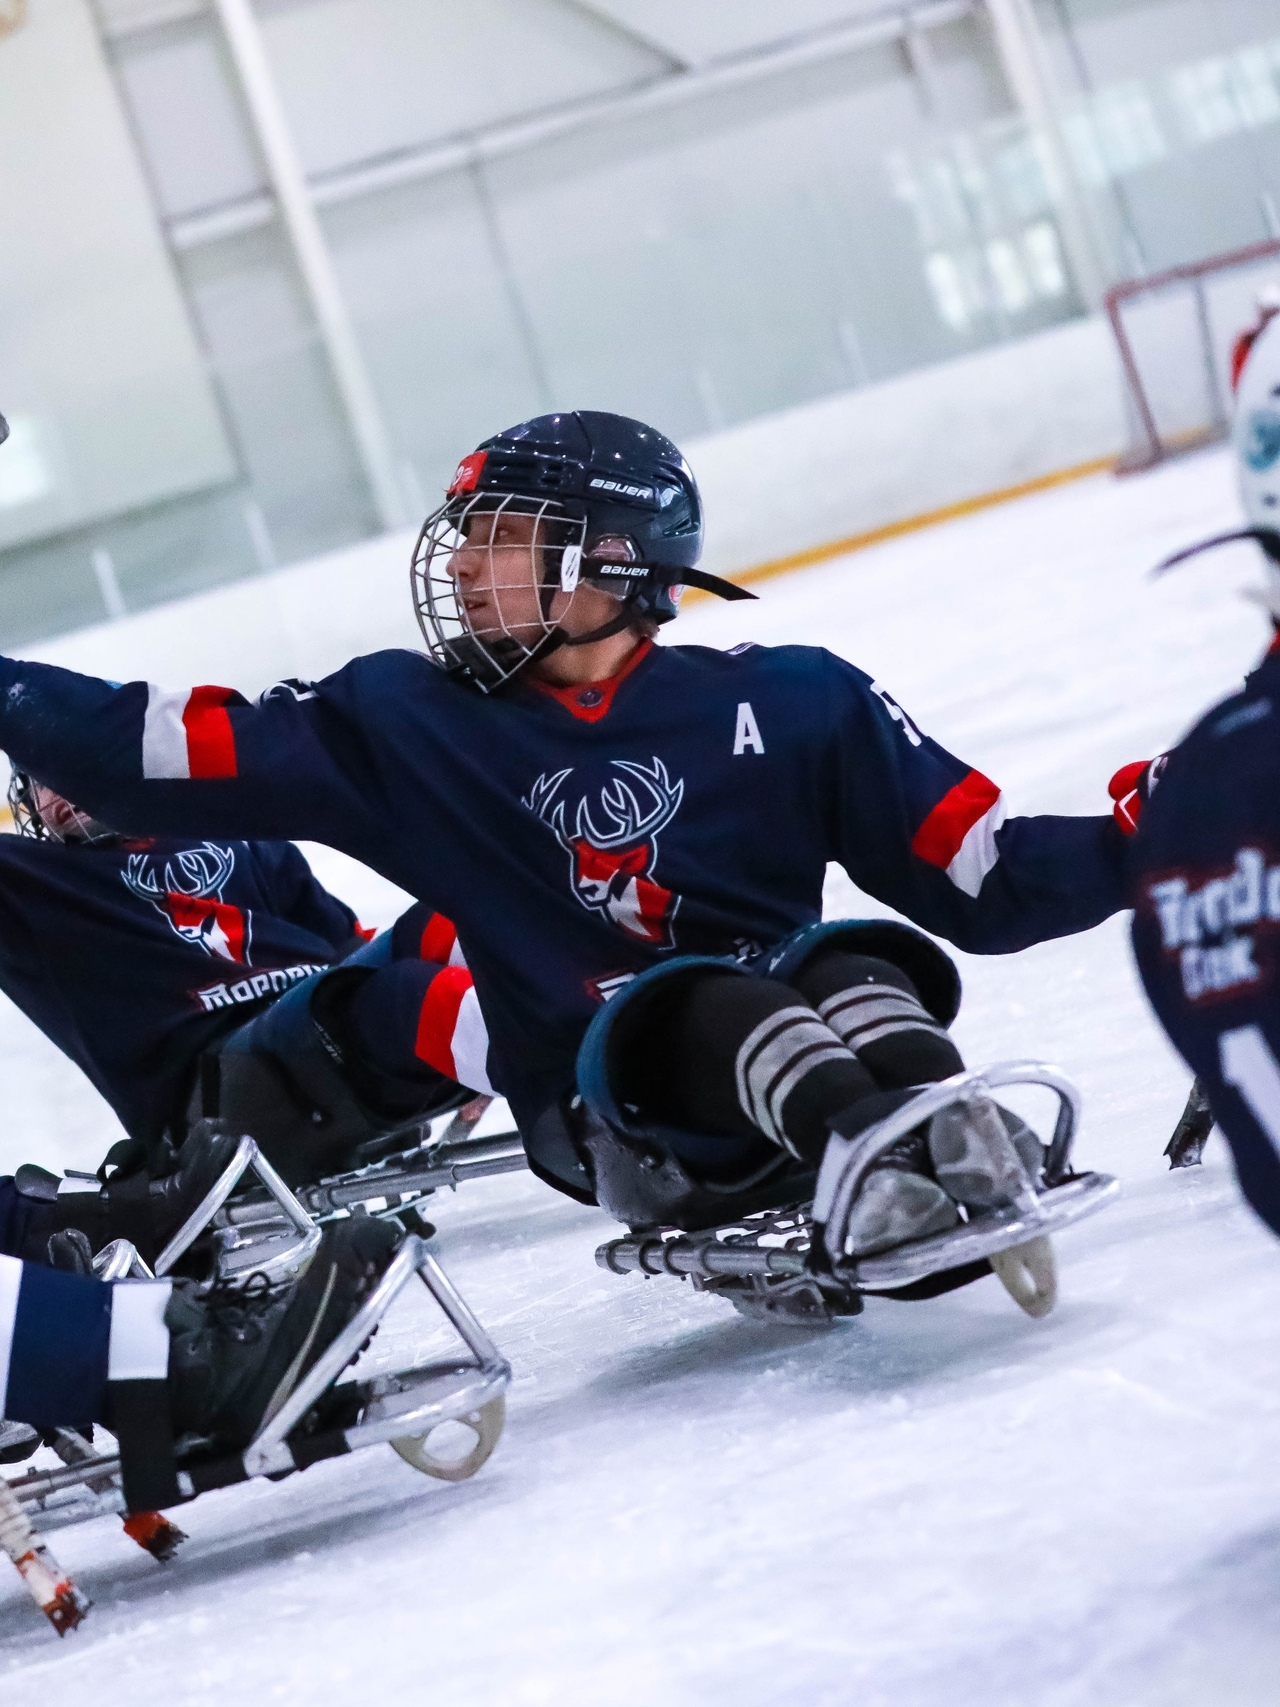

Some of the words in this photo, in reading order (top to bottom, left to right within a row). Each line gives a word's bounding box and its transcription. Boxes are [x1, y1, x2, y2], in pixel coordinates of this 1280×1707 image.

[589, 478, 651, 499] BAUER
[600, 565, 650, 577] BAUER
[733, 702, 765, 755] A
